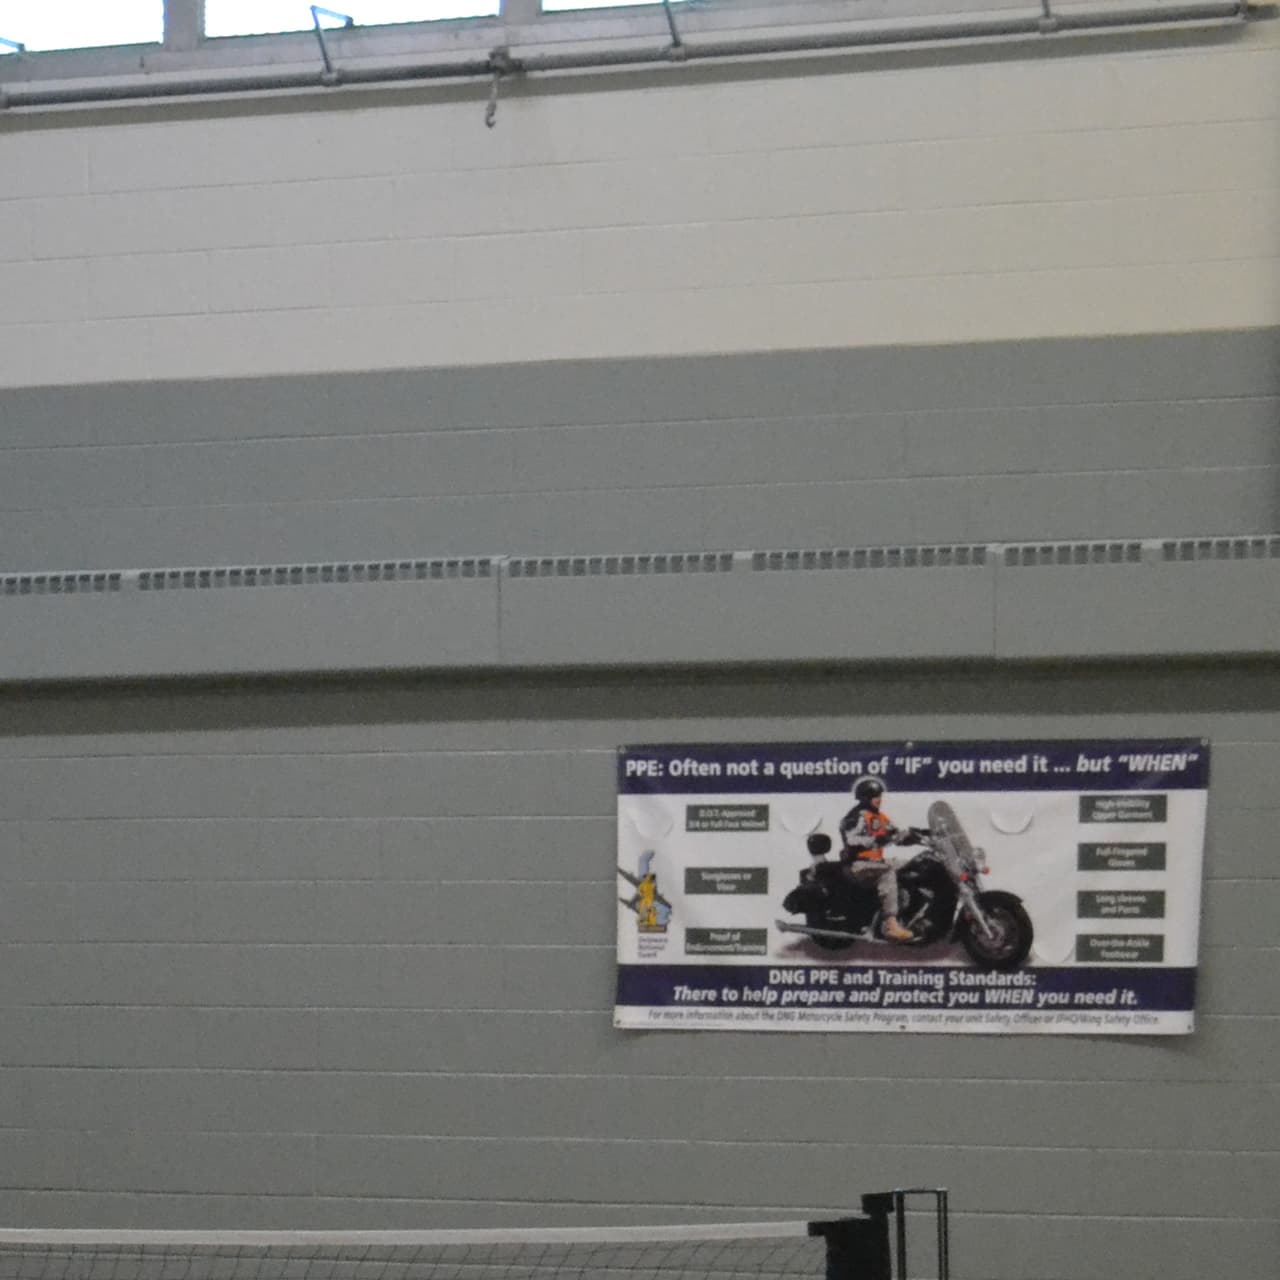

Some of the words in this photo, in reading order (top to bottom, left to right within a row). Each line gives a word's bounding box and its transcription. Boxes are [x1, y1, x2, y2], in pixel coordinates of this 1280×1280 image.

[625, 759, 663, 777] PPE:
[669, 758, 722, 777] Often
[727, 759, 759, 776] not
[764, 761, 775, 776] a
[780, 757, 863, 779] question
[867, 757, 889, 775] of
[938, 758, 974, 778] you
[980, 756, 1027, 773] need
[1032, 755, 1048, 773] it
[1076, 754, 1112, 772] but
[769, 969, 805, 985] DNG
[810, 969, 839, 985] PPE
[843, 970, 874, 985] and
[878, 970, 944, 989] Training
[949, 970, 1037, 987] Standards:
[673, 985, 717, 1002] There
[721, 987, 739, 1002] to
[743, 986, 778, 1006] help
[781, 988, 845, 1006] prepare
[849, 987, 879, 1004] and
[882, 987, 944, 1006] protect
[947, 991, 980, 1007] you
[984, 988, 1035, 1004] WHEN
[1037, 990, 1071, 1008] you
[1074, 988, 1117, 1005] need
[1120, 988, 1138, 1005] it.
